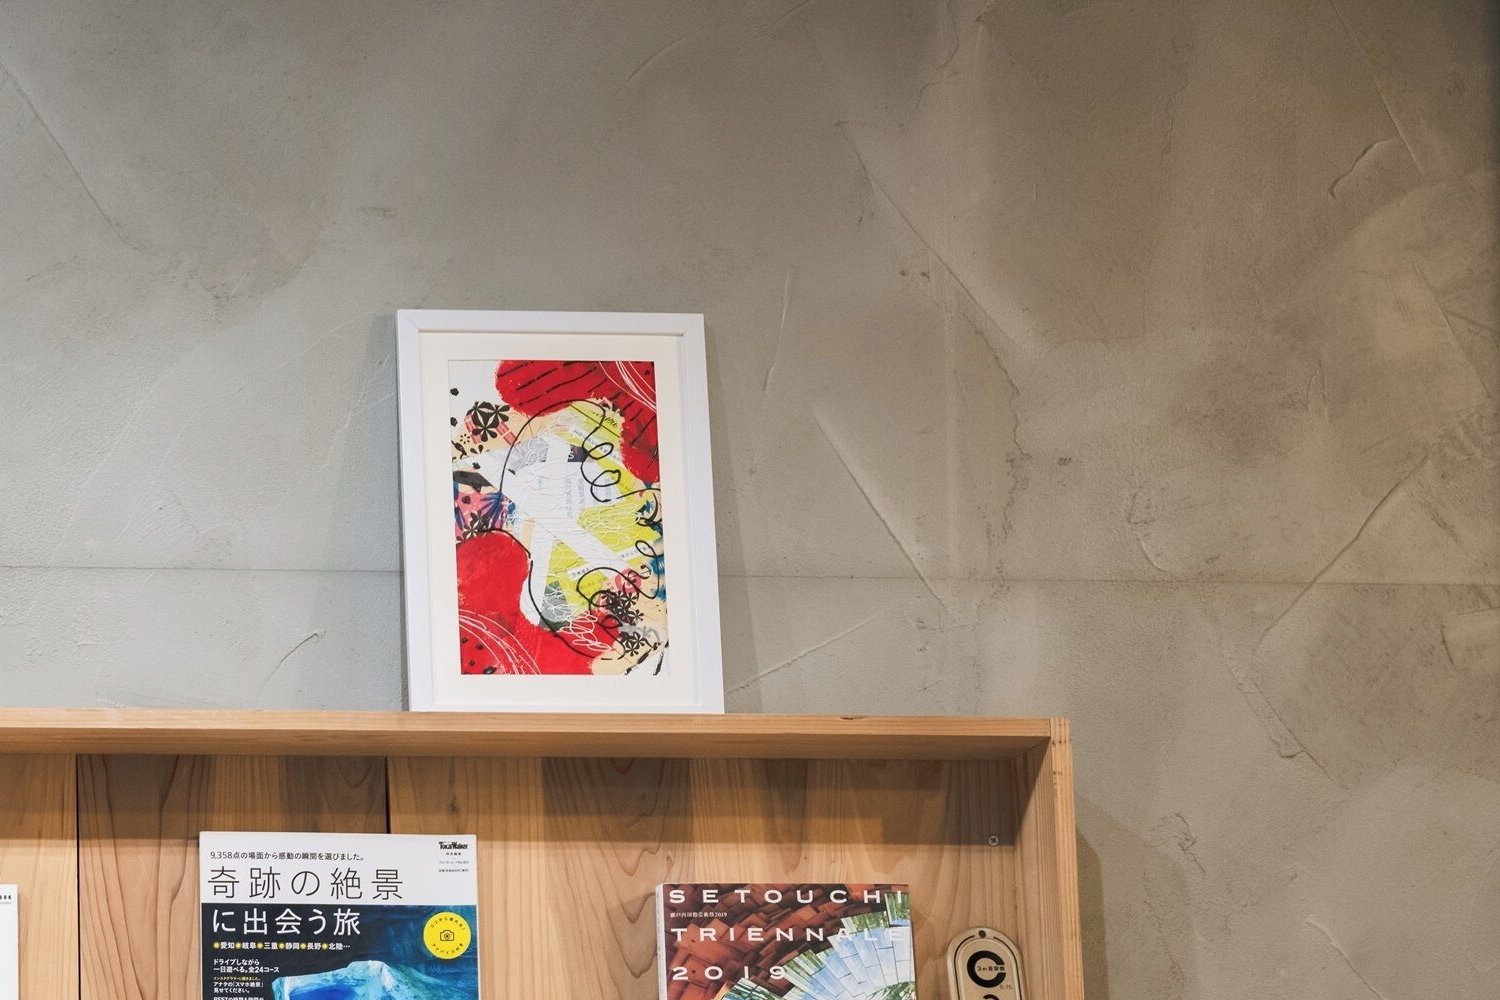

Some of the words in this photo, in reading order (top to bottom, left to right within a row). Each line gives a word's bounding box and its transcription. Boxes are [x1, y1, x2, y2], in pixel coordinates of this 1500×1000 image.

[207, 866, 404, 901] 奇跡の絶景
[669, 889, 903, 904] SETOUCHI
[212, 907, 361, 936] に出会う旅
[670, 927, 904, 942] TRIENNALE
[213, 958, 260, 966] ドライブしながら
[672, 966, 786, 981] 2019
